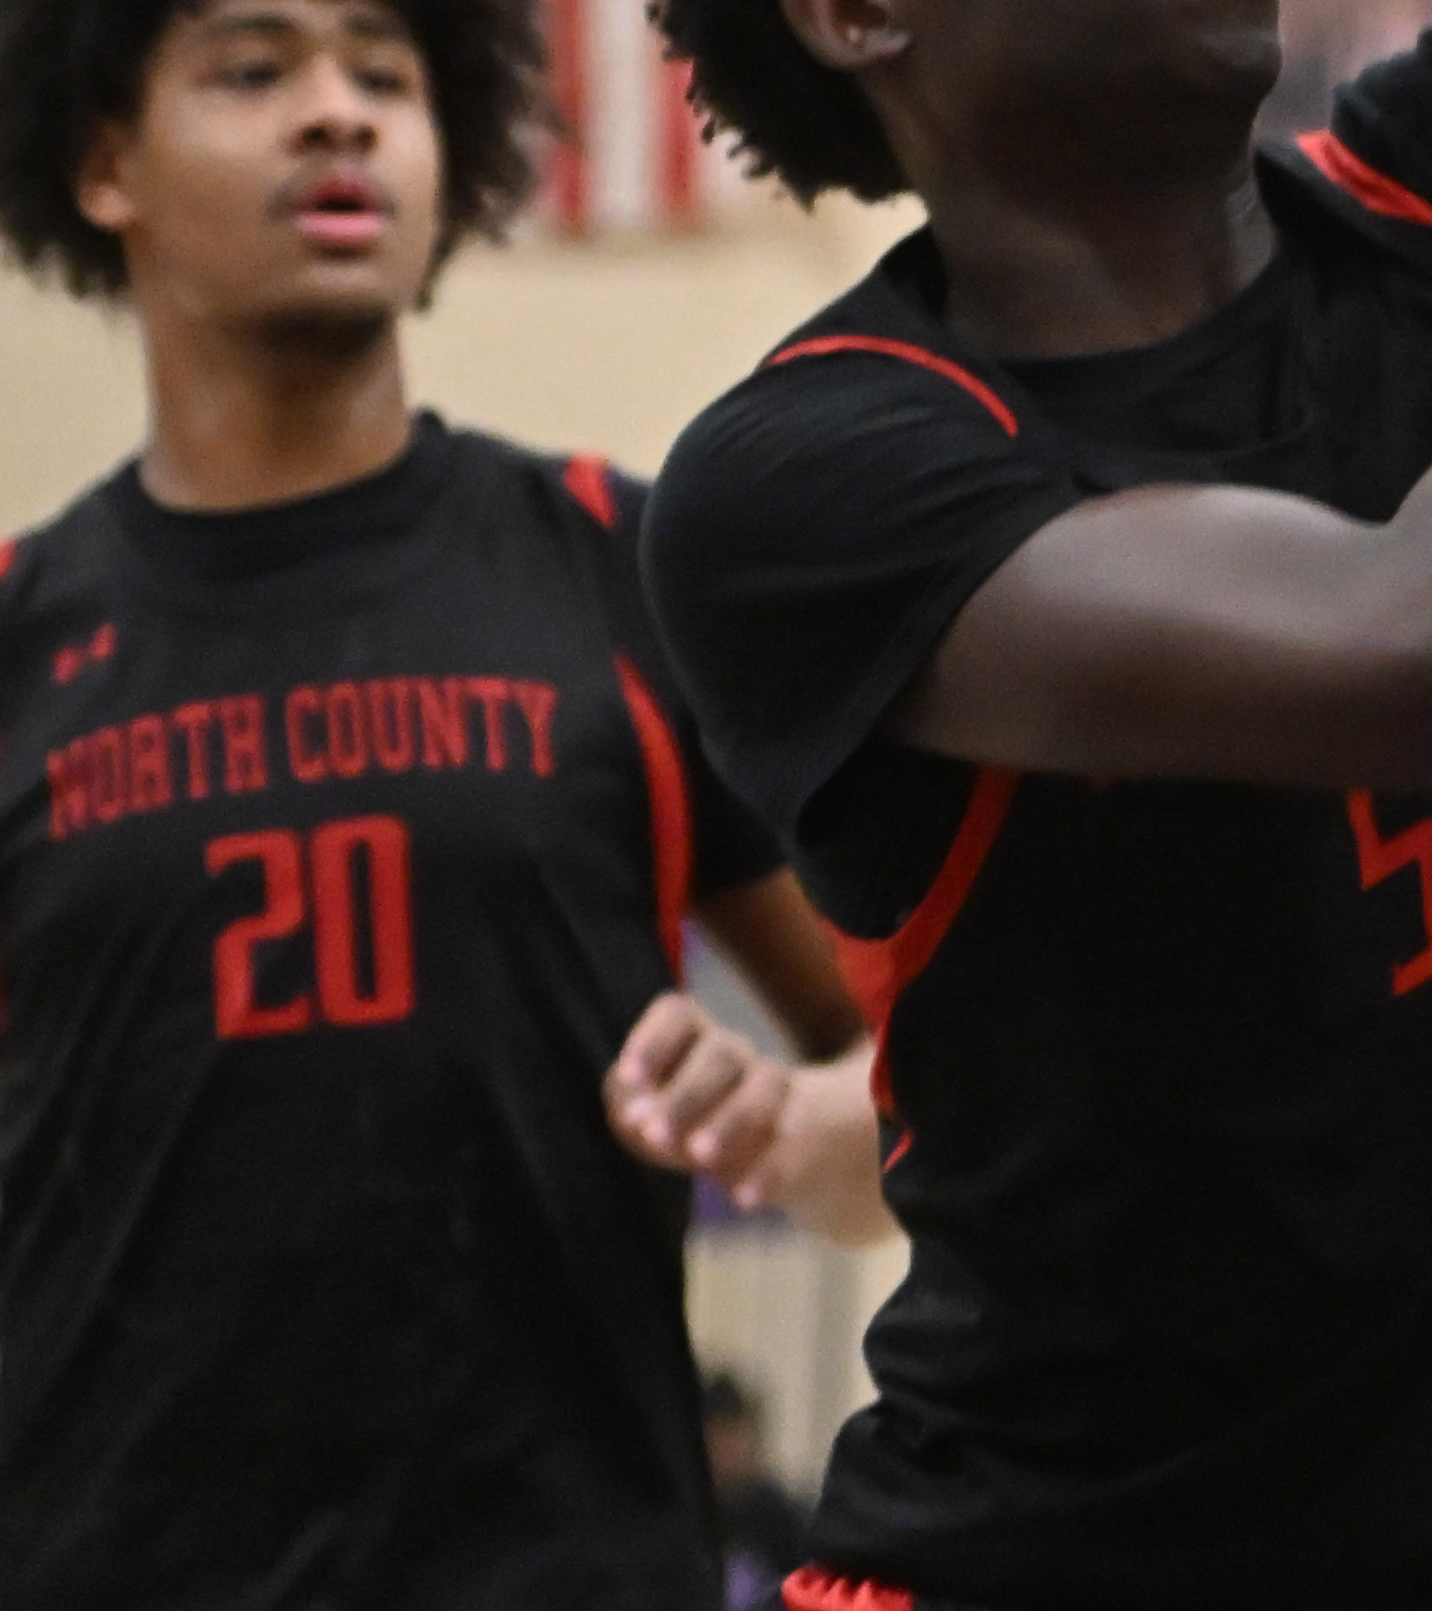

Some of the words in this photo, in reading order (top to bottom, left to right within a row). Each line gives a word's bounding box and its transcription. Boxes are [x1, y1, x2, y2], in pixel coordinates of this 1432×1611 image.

[44, 693, 270, 842] NORTH
[285, 673, 558, 782] COUNTY
[204, 812, 418, 1042] 20
